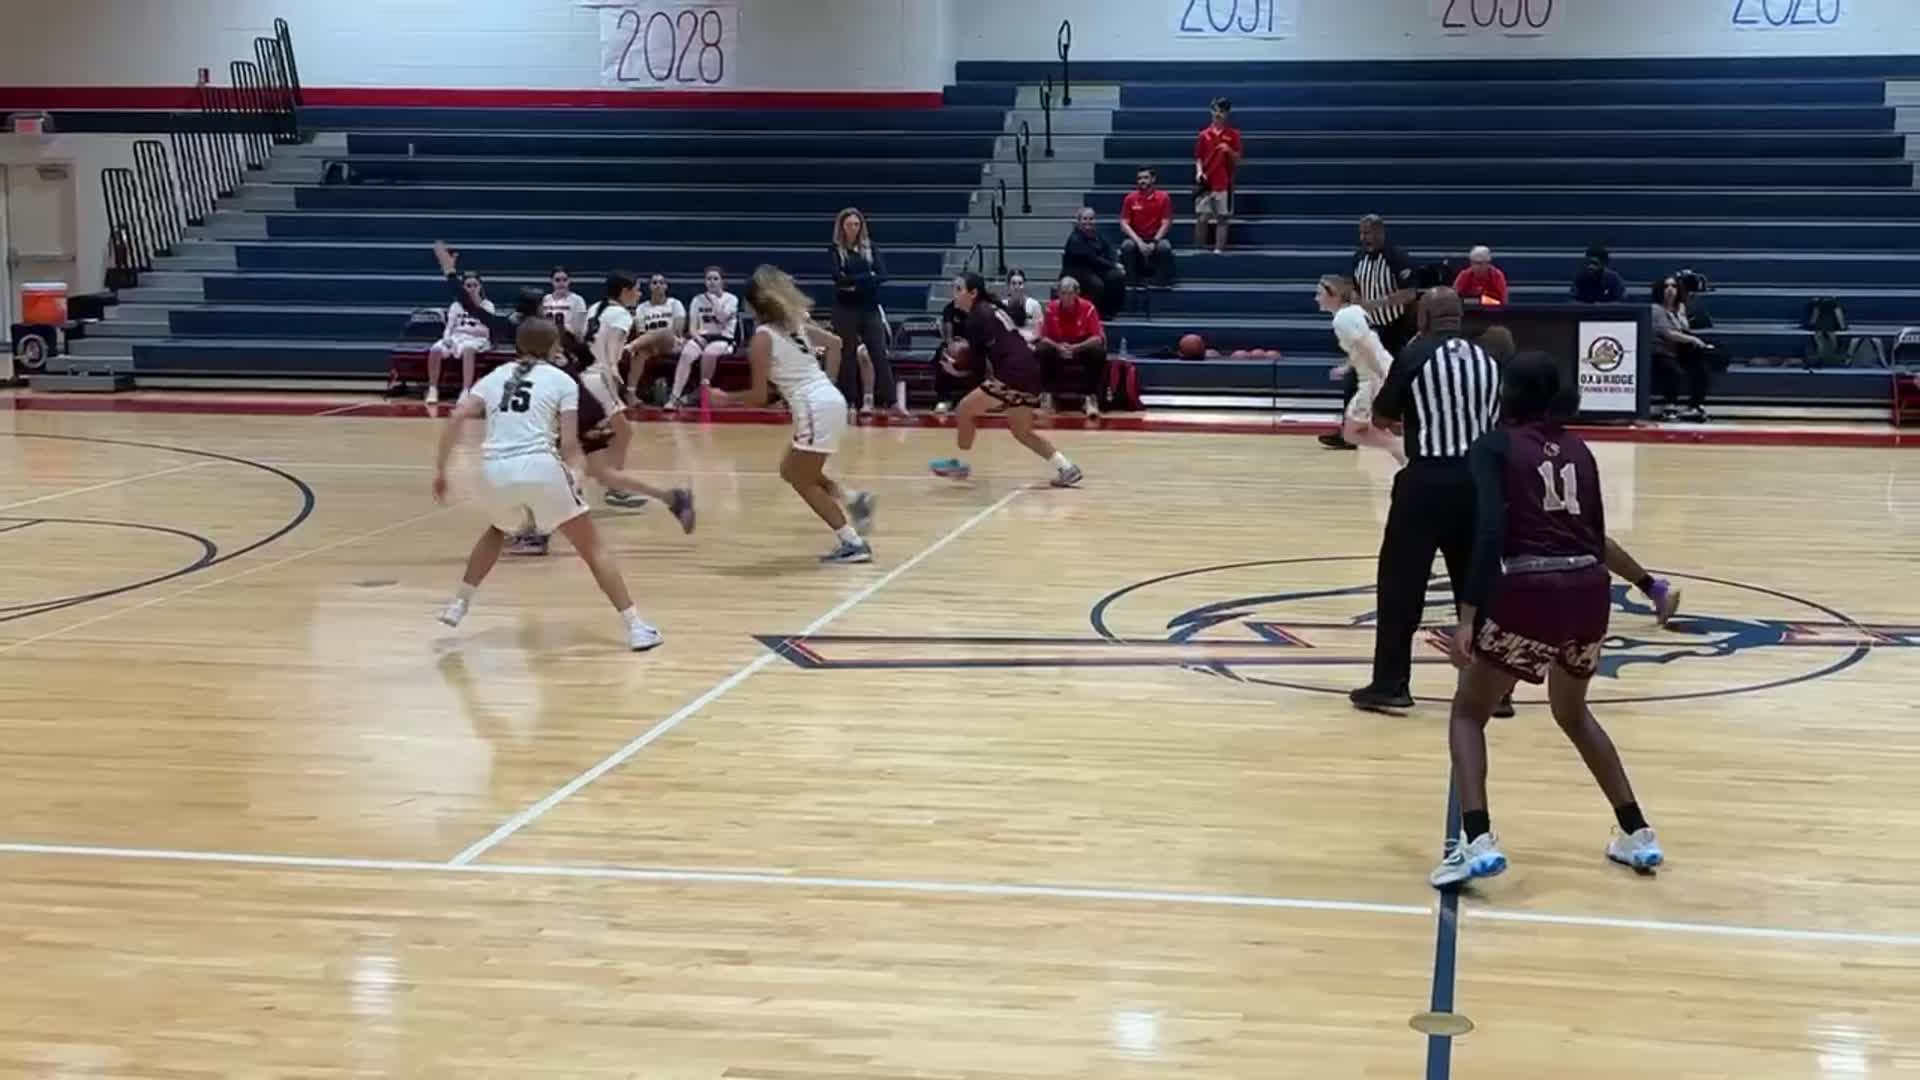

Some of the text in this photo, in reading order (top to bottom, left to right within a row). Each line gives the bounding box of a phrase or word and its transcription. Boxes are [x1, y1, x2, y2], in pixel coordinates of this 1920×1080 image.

[616, 9, 723, 84] 2028
[497, 379, 534, 413] 15
[1536, 460, 1581, 516] 11
